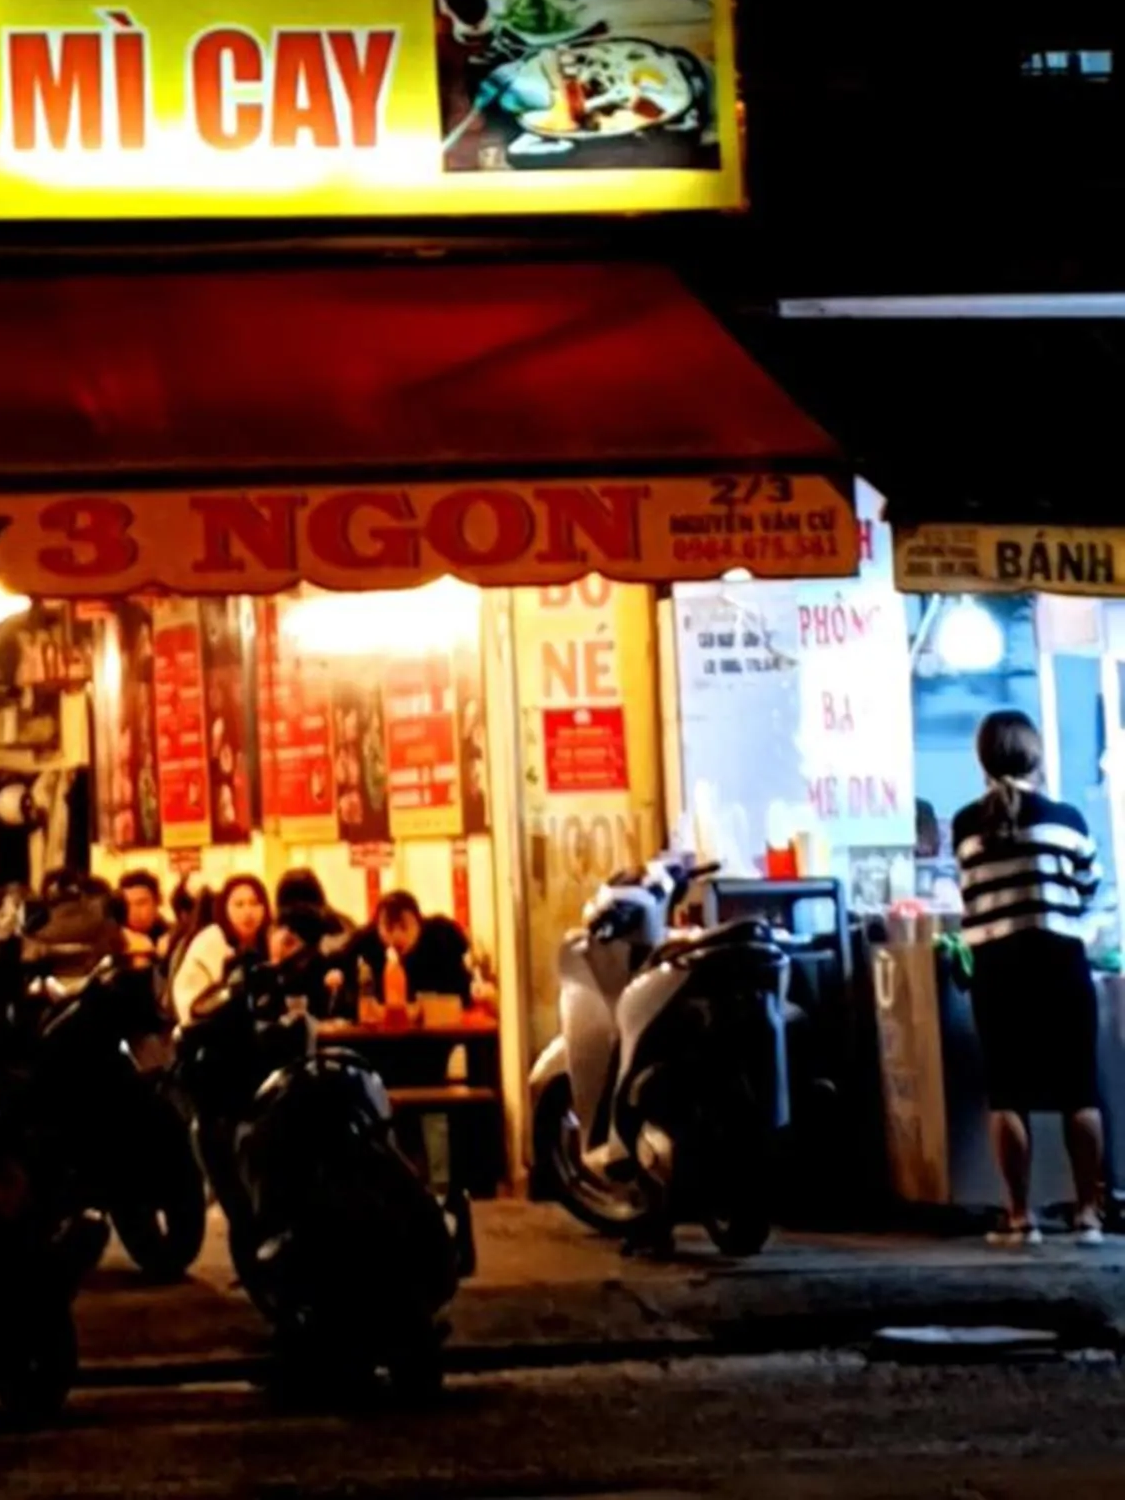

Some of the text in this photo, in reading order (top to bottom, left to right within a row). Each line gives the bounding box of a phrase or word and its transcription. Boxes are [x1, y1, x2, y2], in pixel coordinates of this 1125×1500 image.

[8, 9, 146, 150] MÌ
[192, 28, 397, 151] CAY
[36, 498, 139, 578] 3
[189, 484, 652, 575] NGON
[995, 530, 1114, 583] BÁNH
[541, 622, 618, 699] NÉ
